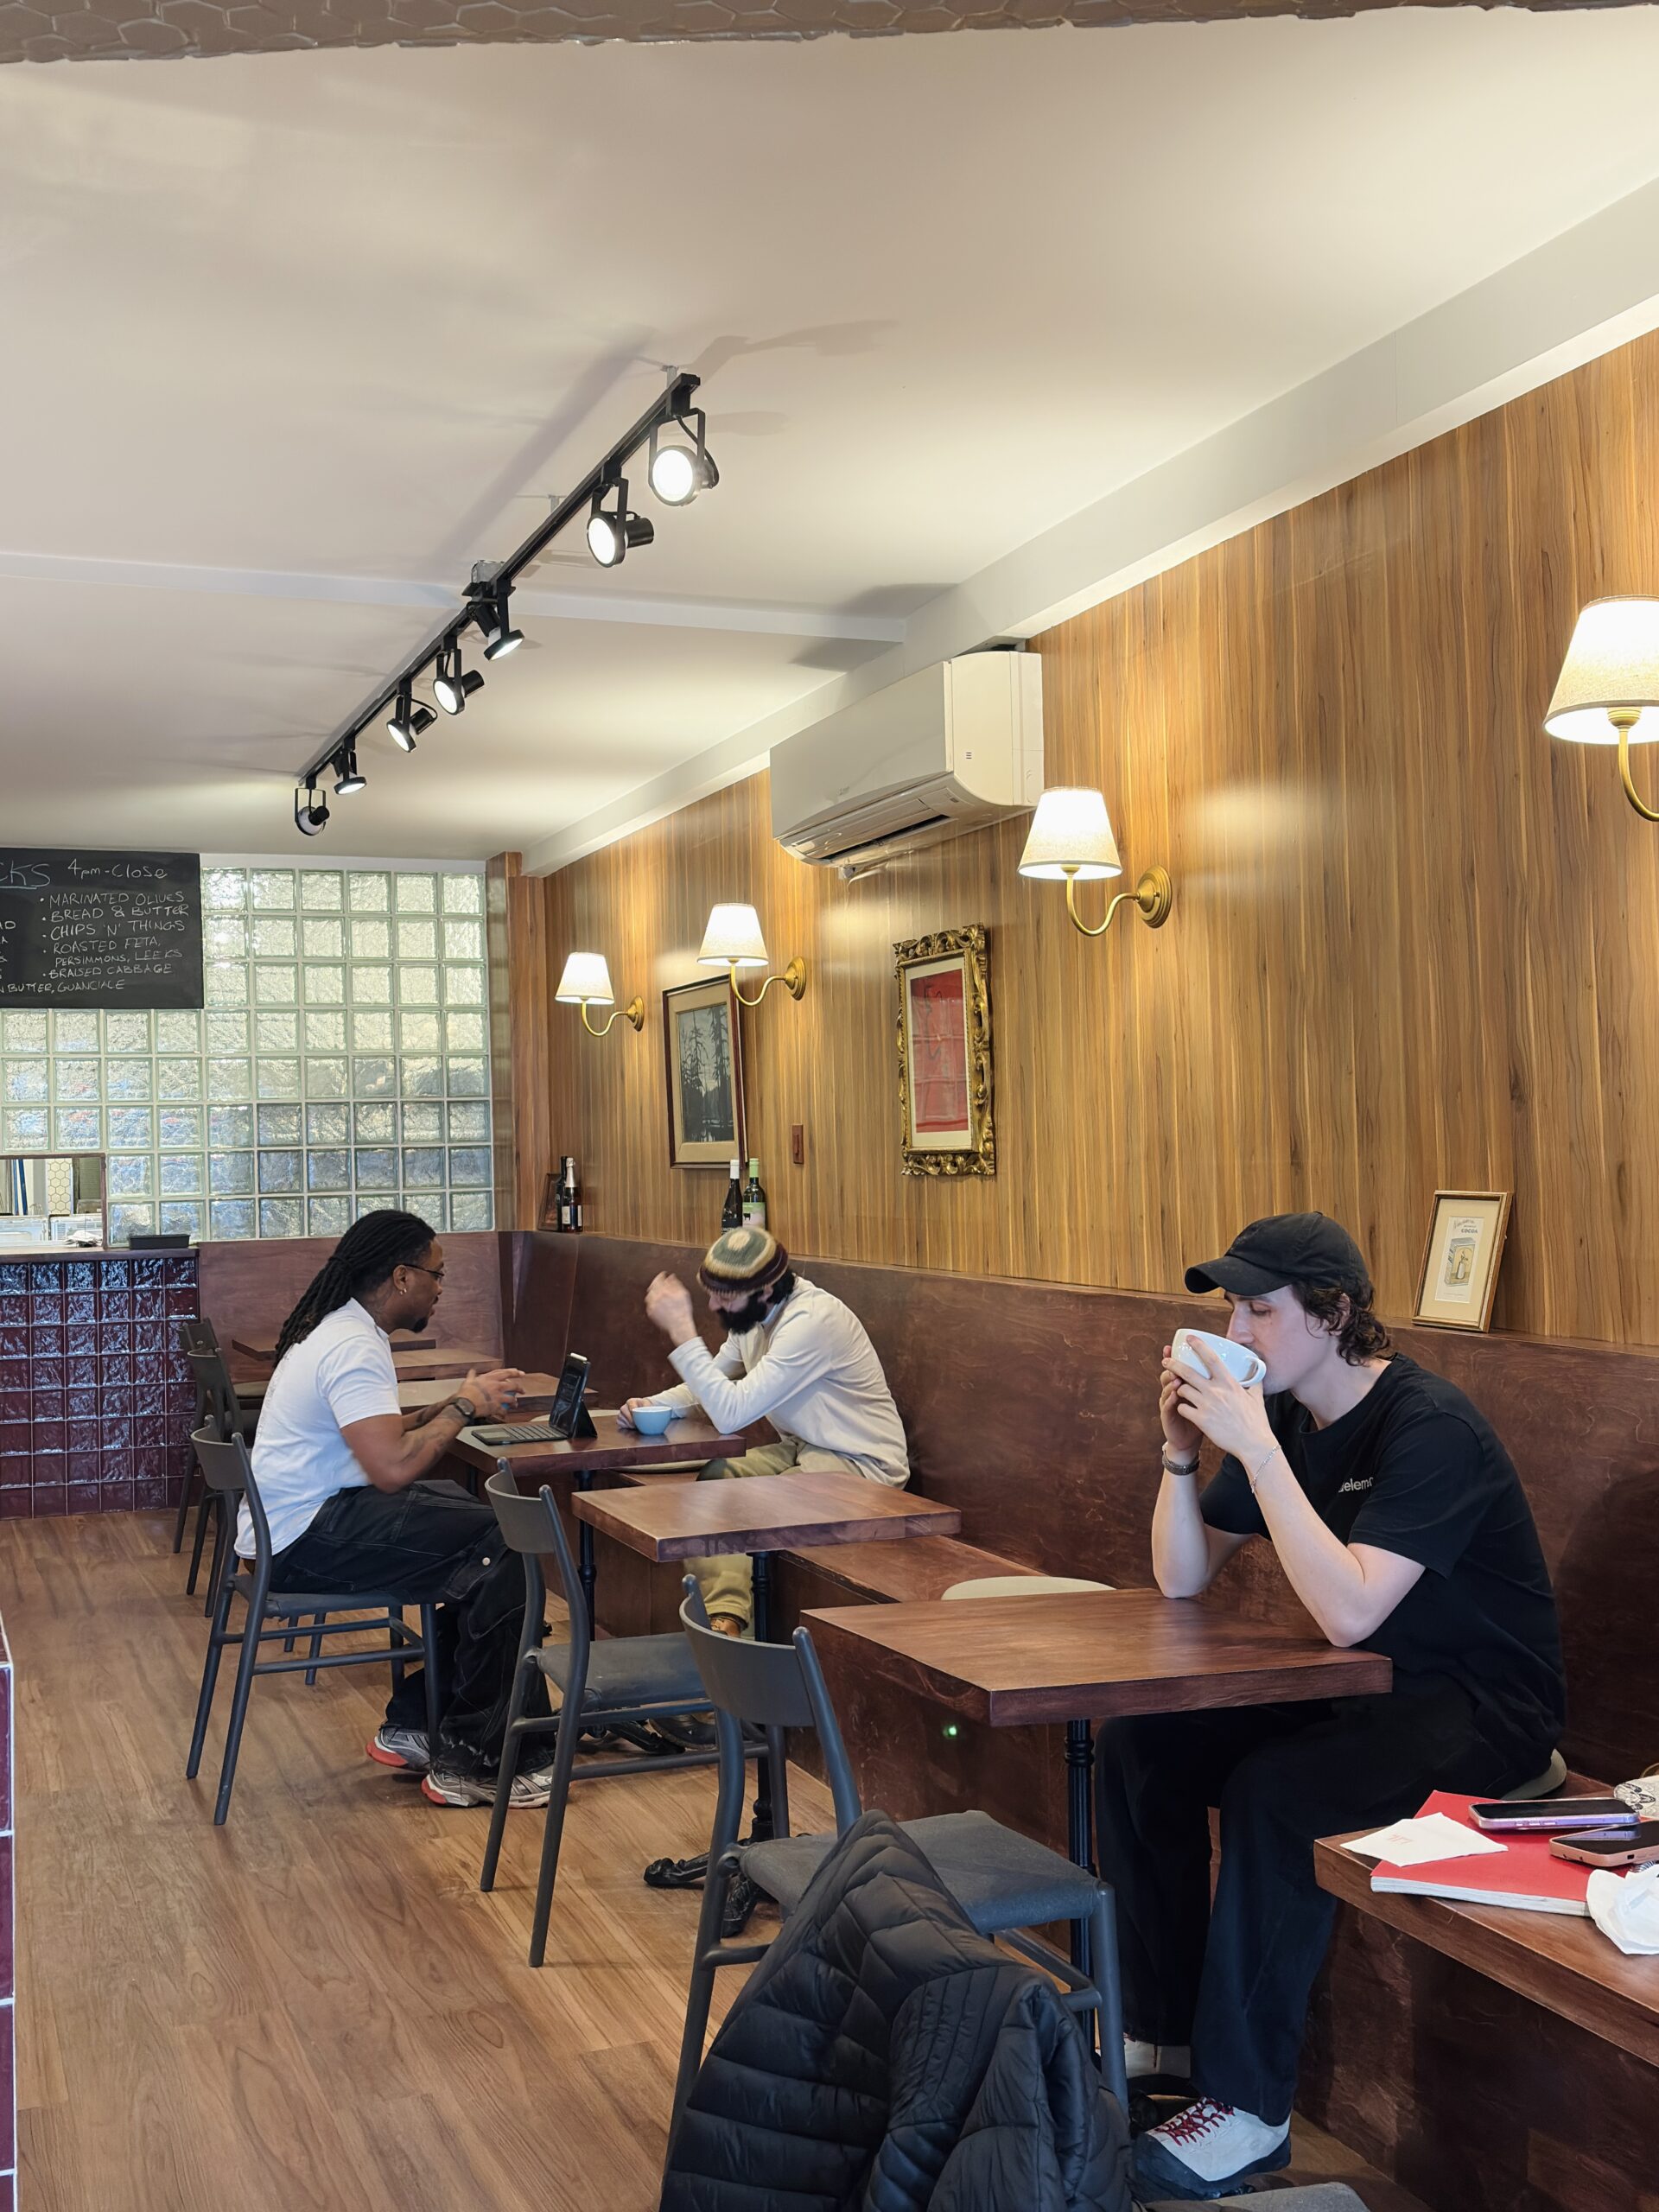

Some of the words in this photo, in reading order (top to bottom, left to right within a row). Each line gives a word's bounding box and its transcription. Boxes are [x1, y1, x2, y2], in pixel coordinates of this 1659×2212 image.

[49, 893, 129, 909] MARINATED
[135, 891, 184, 906] OLIVES
[51, 907, 104, 923] BREAD
[111, 905, 125, 917] &
[131, 904, 189, 917] BUTTER
[50, 924, 96, 940] CHIPS
[127, 919, 185, 932] THINGS
[54, 940, 118, 954] ROASTED
[55, 954, 130, 968] PERSIMMONS,
[135, 949, 182, 961] LEEKS
[48, 967, 102, 979] BRAISED
[106, 963, 173, 975] CABBAGE
[57, 979, 125, 992] GUANCIALE
